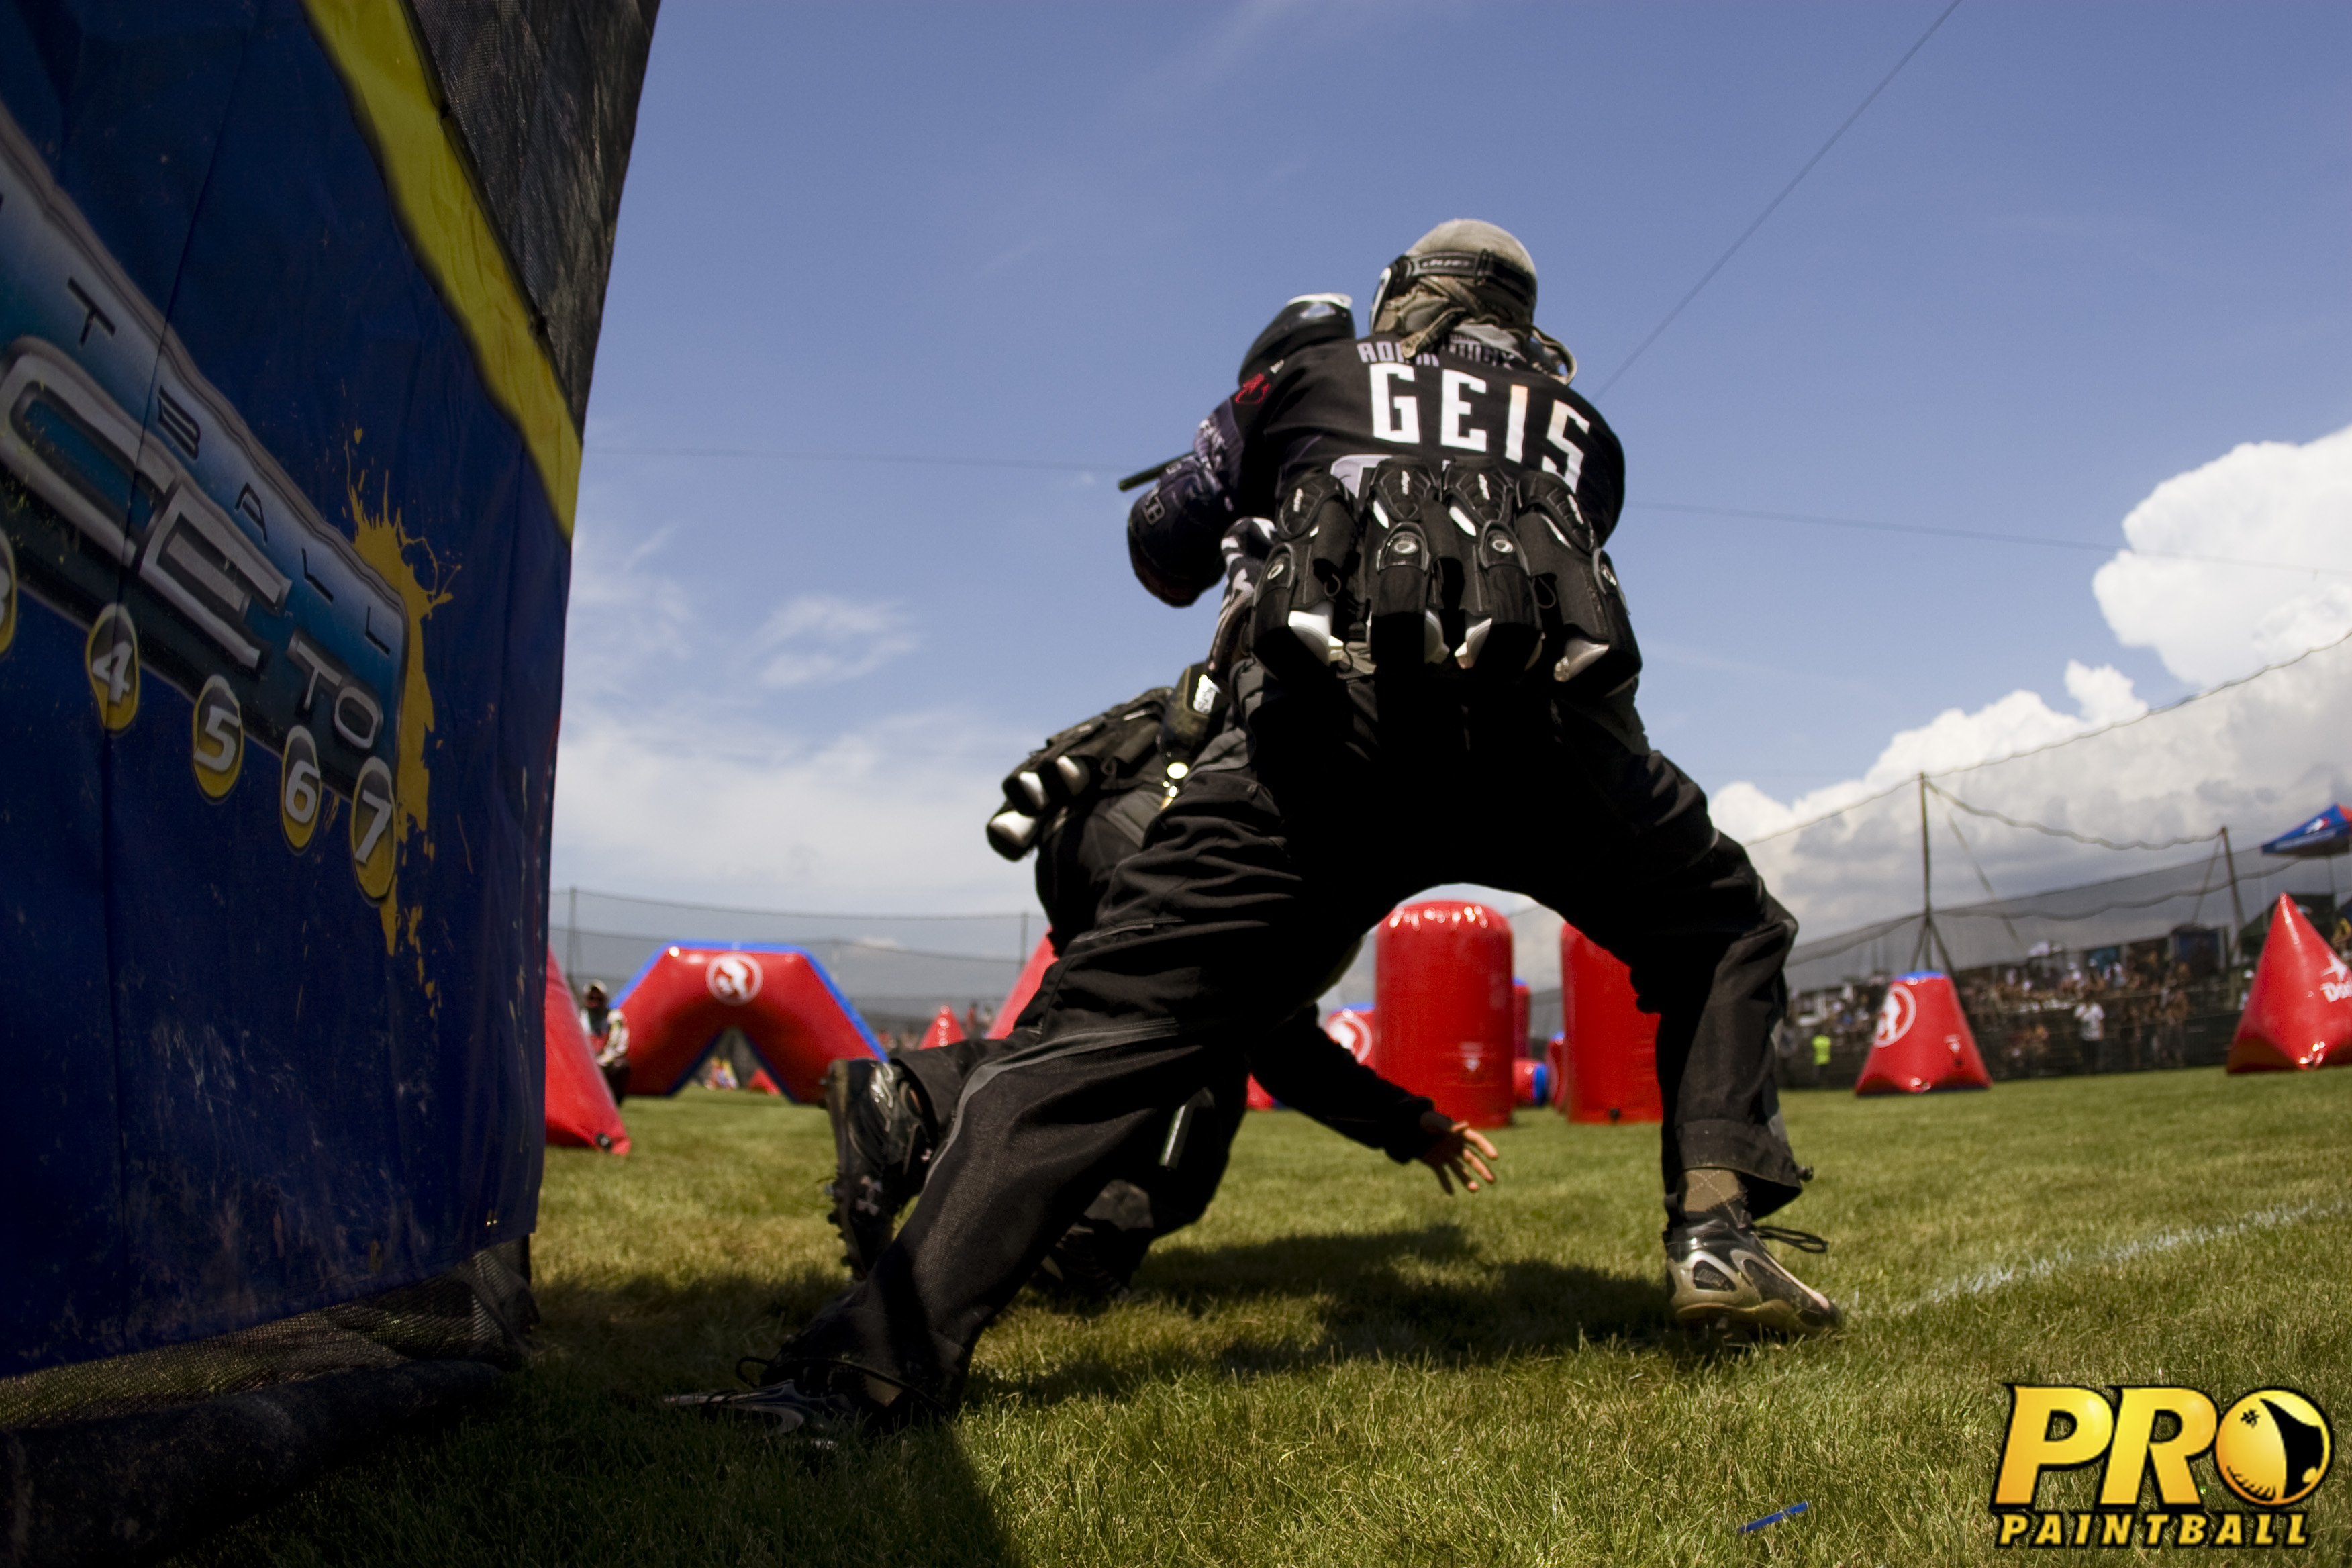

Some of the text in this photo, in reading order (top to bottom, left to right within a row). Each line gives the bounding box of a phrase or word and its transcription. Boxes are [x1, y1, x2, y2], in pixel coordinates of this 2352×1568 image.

[1369, 362, 1590, 493] GEIS
[91, 640, 392, 865] 4 5 6 7
[289, 630, 382, 750] TO
